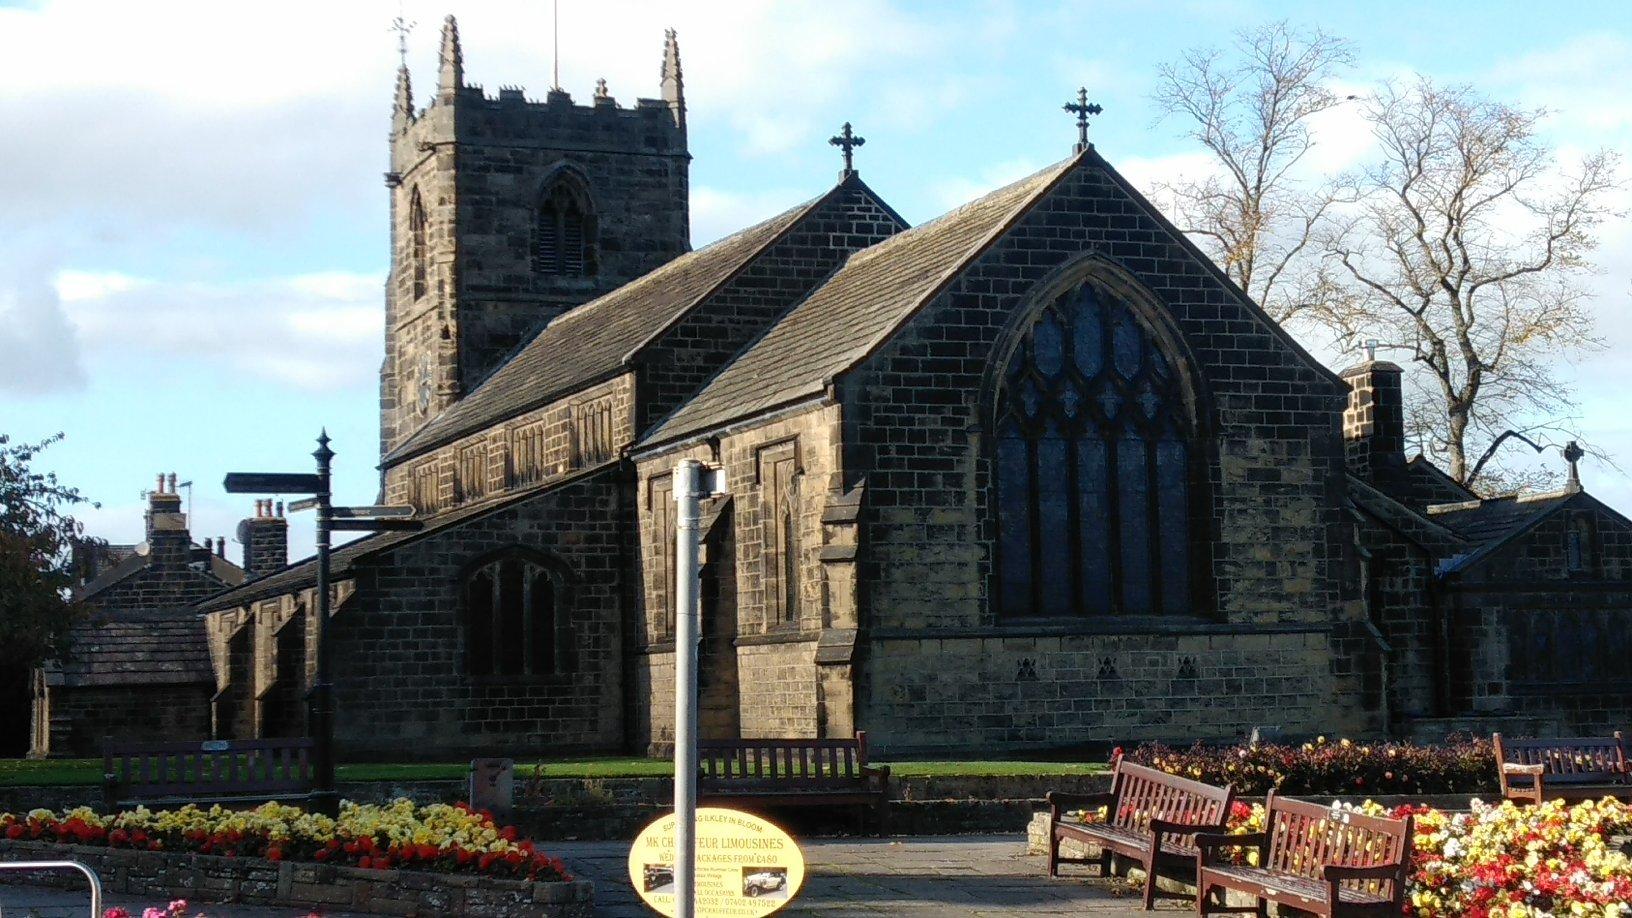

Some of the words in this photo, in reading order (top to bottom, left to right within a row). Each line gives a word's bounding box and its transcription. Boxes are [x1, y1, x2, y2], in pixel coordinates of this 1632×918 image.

[705, 814, 728, 823] ILKLEY
[738, 818, 762, 833] BLOOM
[646, 837, 659, 848] MK
[721, 838, 784, 849] LIMOUSINES
[697, 855, 733, 863] ACKAGES
[734, 855, 754, 863] FROM
